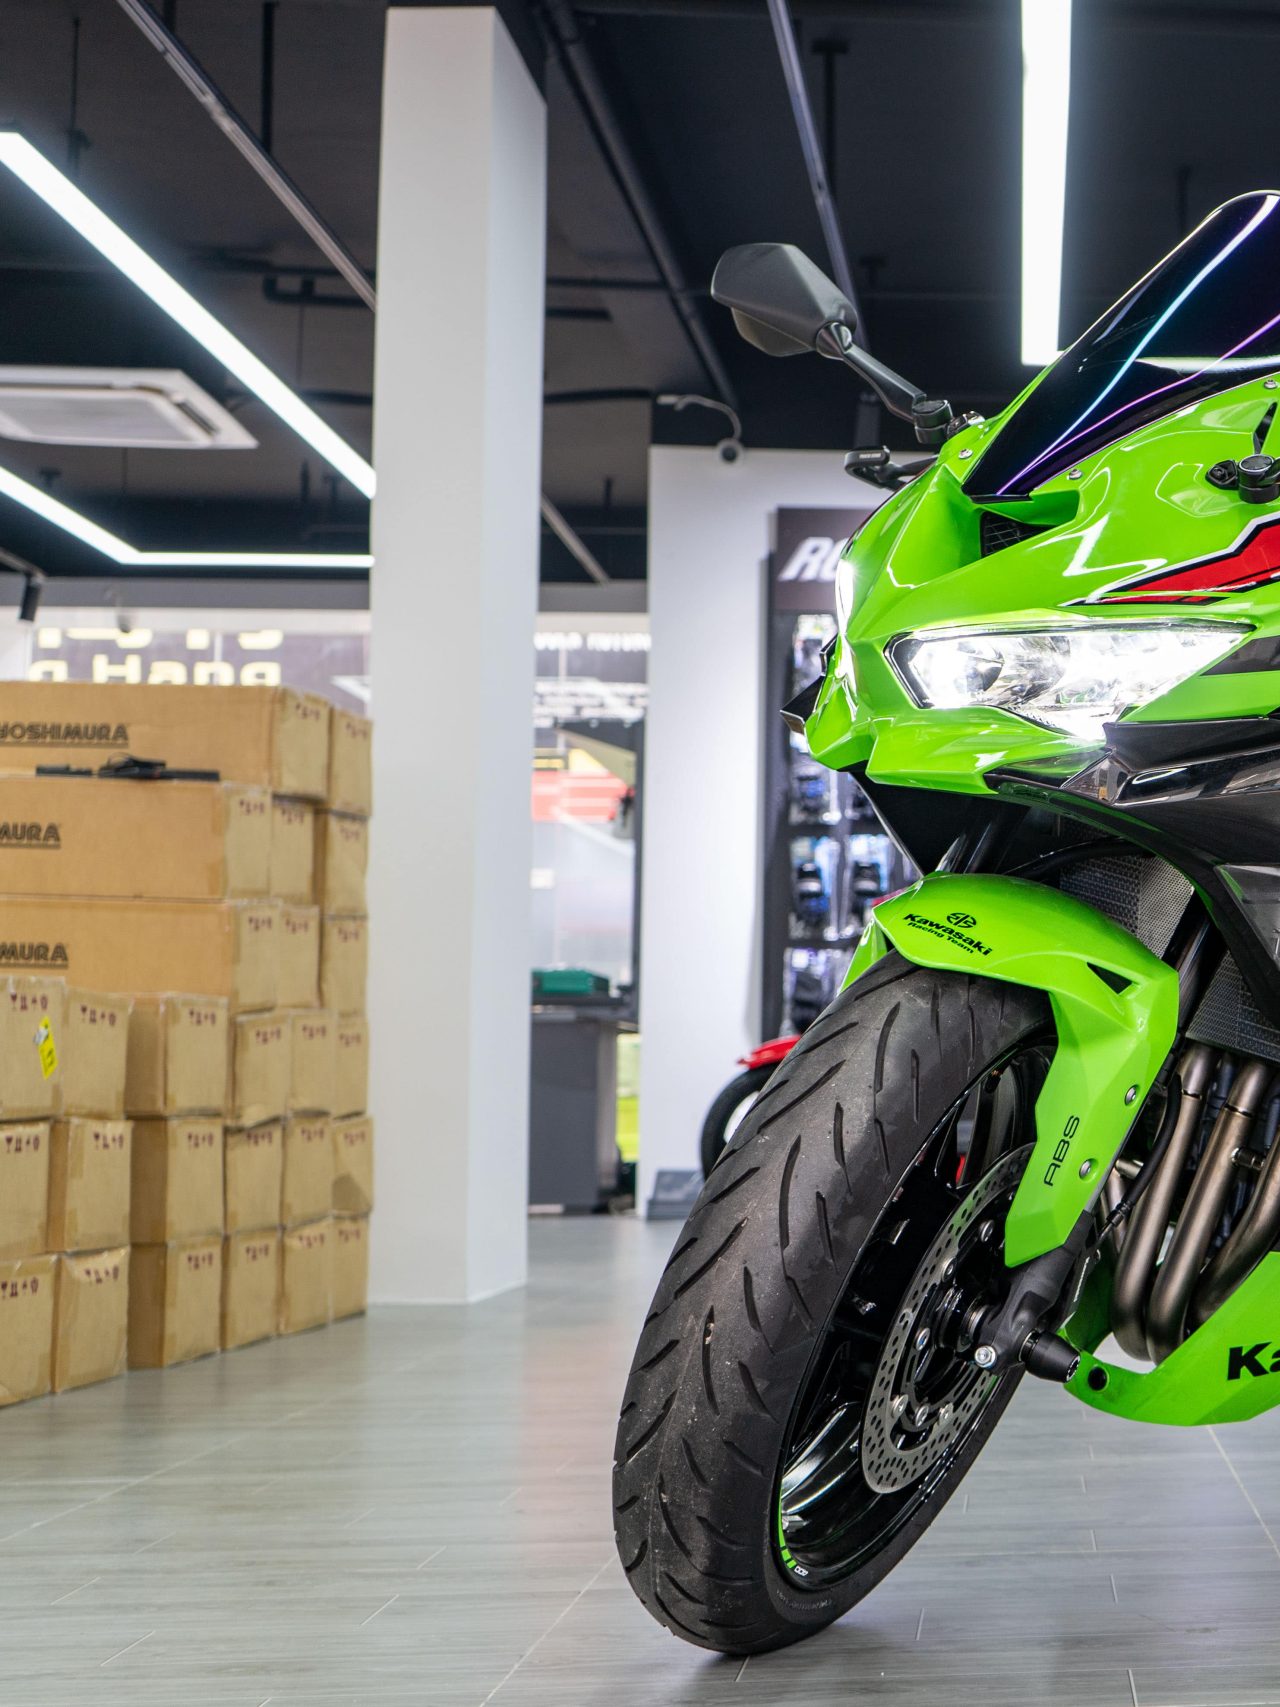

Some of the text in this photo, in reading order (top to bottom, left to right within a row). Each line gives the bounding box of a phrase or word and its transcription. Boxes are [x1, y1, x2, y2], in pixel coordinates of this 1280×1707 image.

[903, 913, 993, 956] Kawasaki
[907, 922, 974, 954] Racing Team
[1044, 1115, 1080, 1187] ABS
